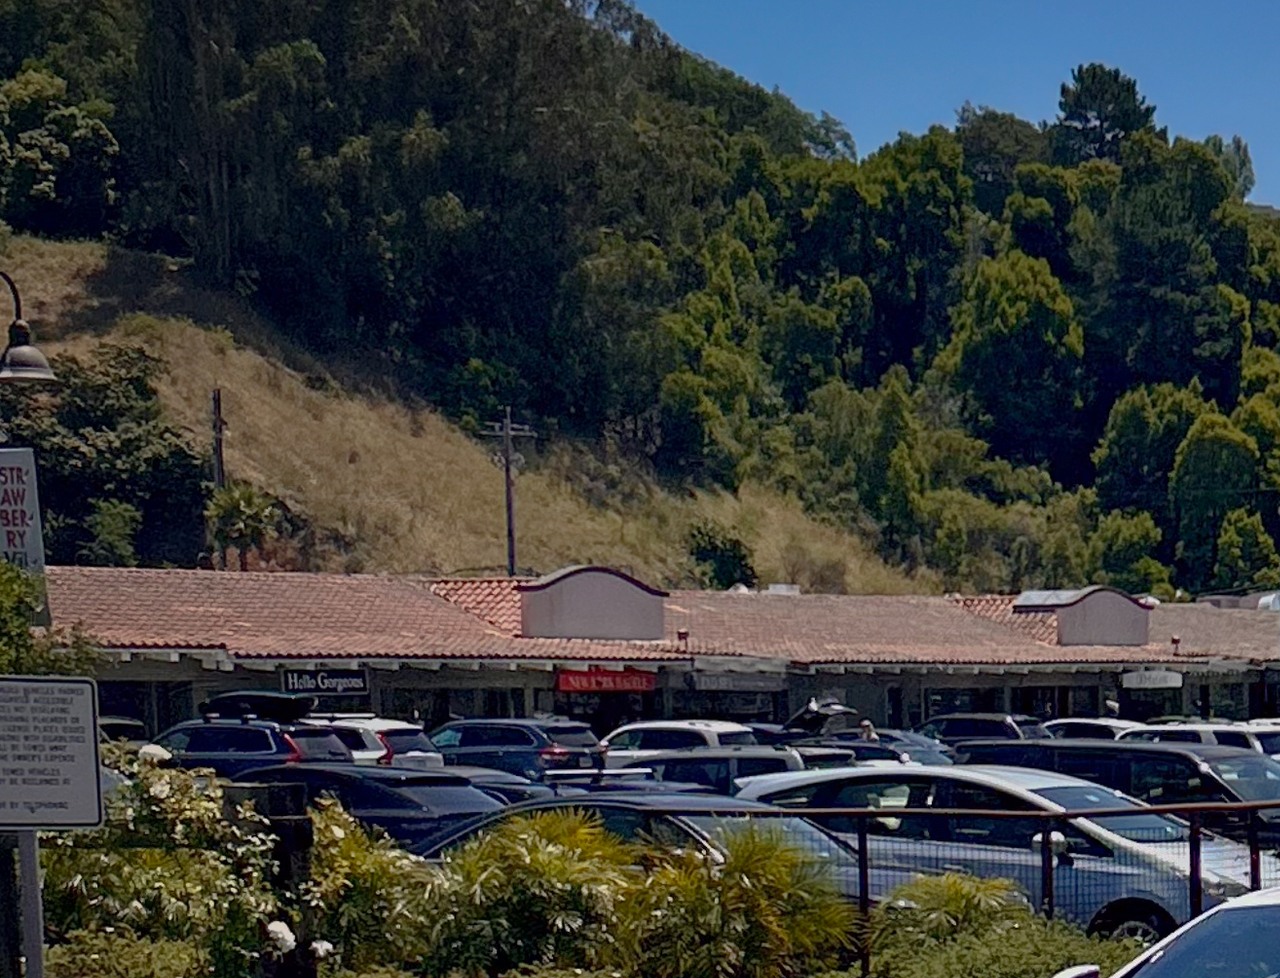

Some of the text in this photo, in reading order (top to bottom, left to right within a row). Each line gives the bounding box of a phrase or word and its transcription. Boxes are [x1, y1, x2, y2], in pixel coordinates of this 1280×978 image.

[0, 467, 25, 485] STR
[1, 488, 26, 507] AW
[0, 509, 29, 527] BER
[6, 530, 27, 548] RY
[287, 671, 364, 693] Hello Gorgeous
